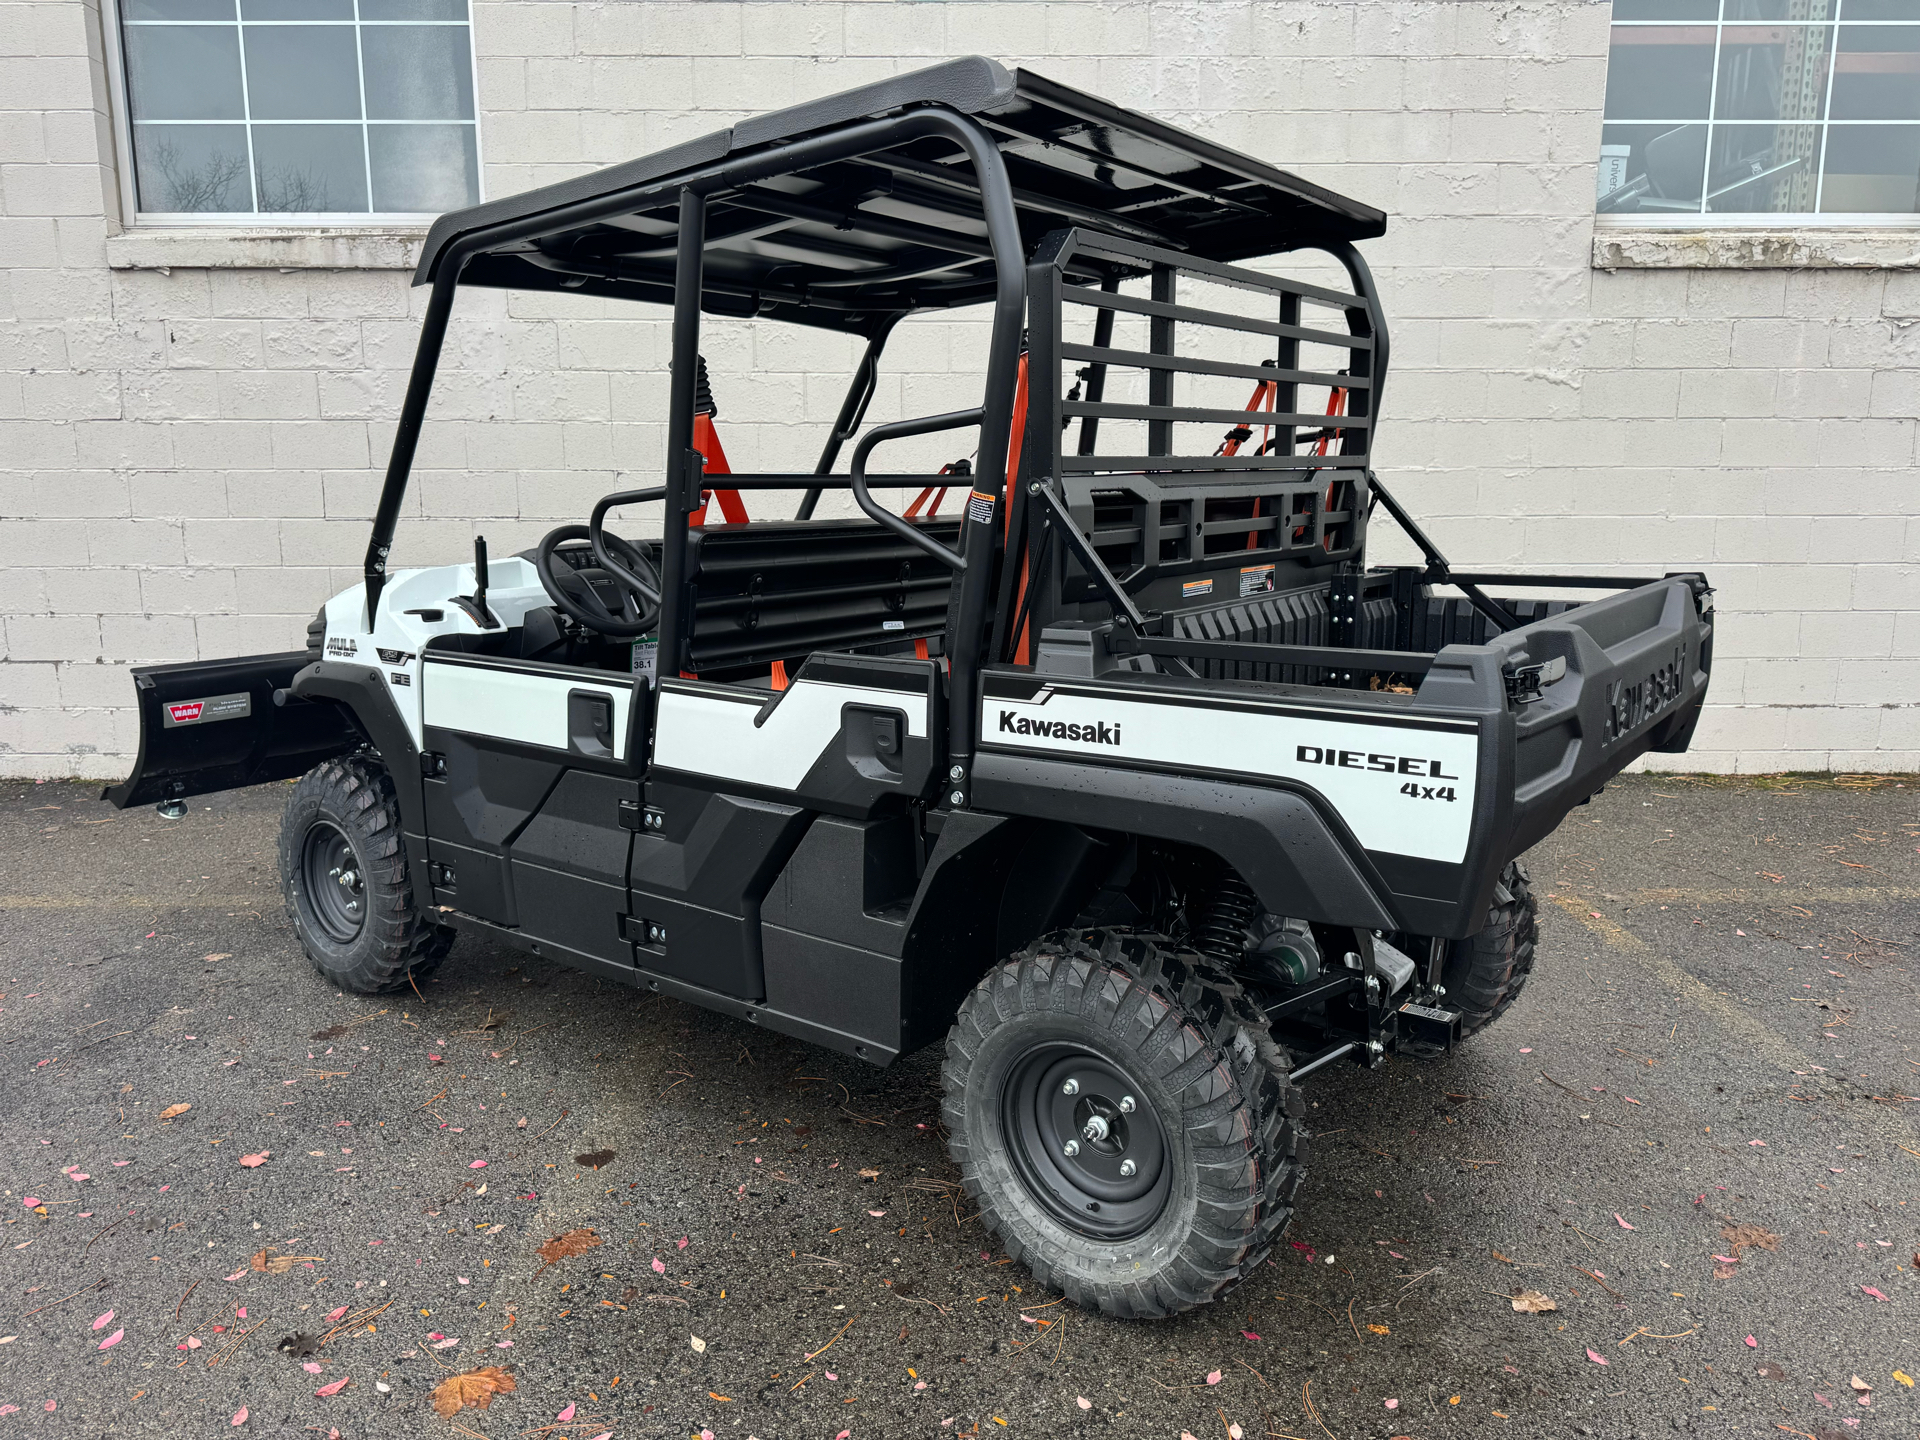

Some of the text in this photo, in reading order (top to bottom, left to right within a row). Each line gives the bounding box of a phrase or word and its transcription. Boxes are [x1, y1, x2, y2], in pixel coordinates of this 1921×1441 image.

[326, 637, 358, 652] MULE
[633, 659, 651, 669] 38.1
[391, 672, 411, 687] FE
[1602, 642, 1686, 748] Kawasaki
[174, 708, 199, 717] WARN
[999, 710, 1121, 746] Kawasaki
[1296, 745, 1459, 780] DIESEL
[1400, 782, 1457, 802] 4x4
